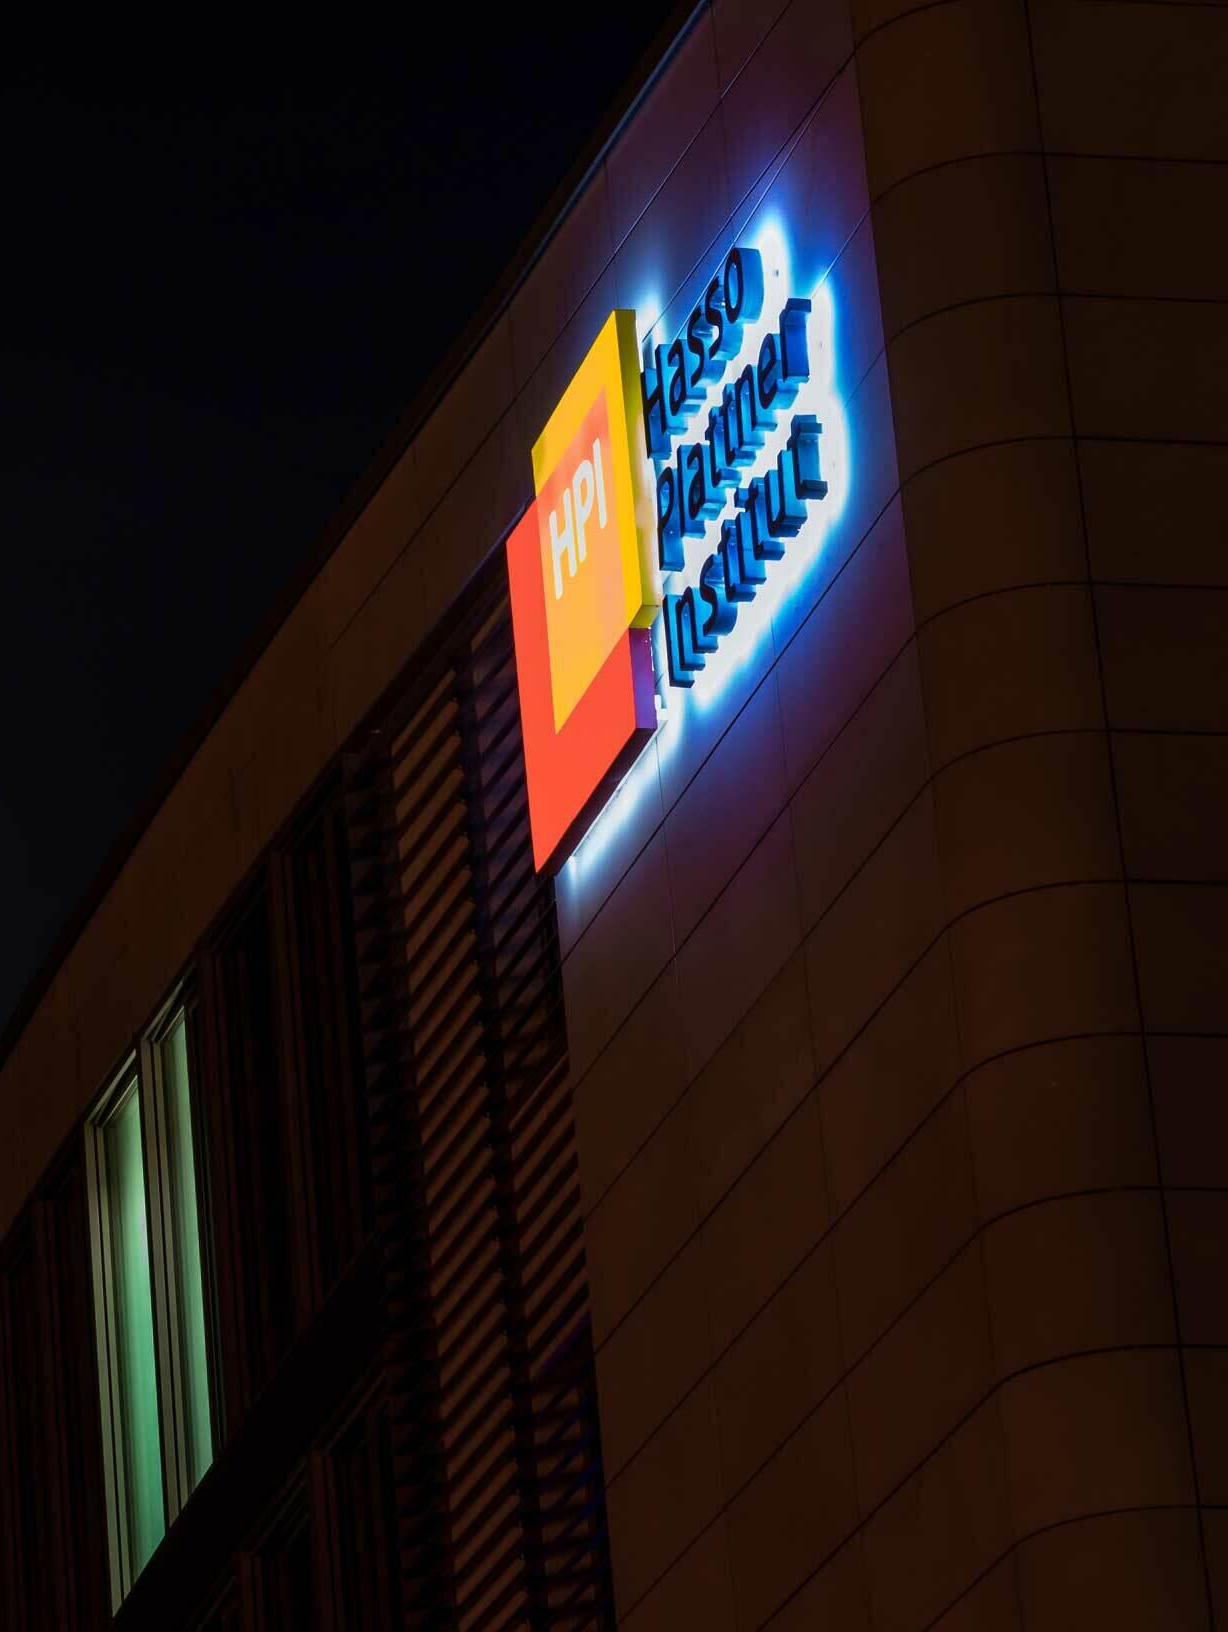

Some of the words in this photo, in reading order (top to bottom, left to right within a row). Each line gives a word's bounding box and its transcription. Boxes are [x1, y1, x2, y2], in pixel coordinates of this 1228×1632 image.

[640, 248, 760, 459] Hasso
[656, 298, 810, 571] Plattner
[549, 438, 607, 600] HPI
[663, 414, 827, 687] Institut
